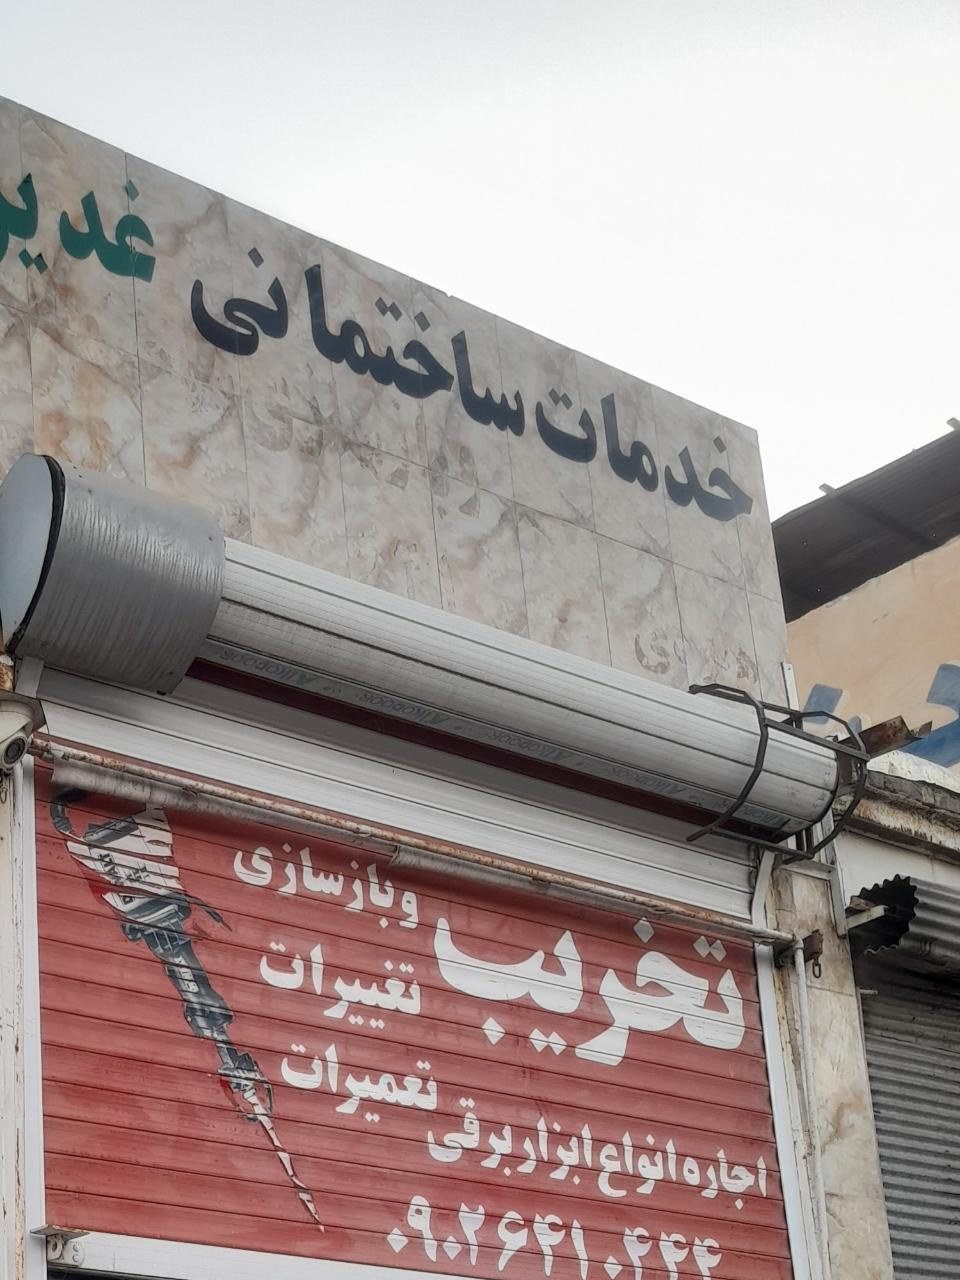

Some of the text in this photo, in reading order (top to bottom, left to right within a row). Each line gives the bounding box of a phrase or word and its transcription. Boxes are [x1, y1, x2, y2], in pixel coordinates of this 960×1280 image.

[190, 247, 523, 437] ساختمانی
[534, 388, 753, 524] خدمات
[260, 941, 420, 1030] تغییرات
[433, 916, 746, 1067] تخریب
[281, 1043, 438, 1123] تعمیرات
[427, 1097, 767, 1210] اجاره انواع ابزار برقی
